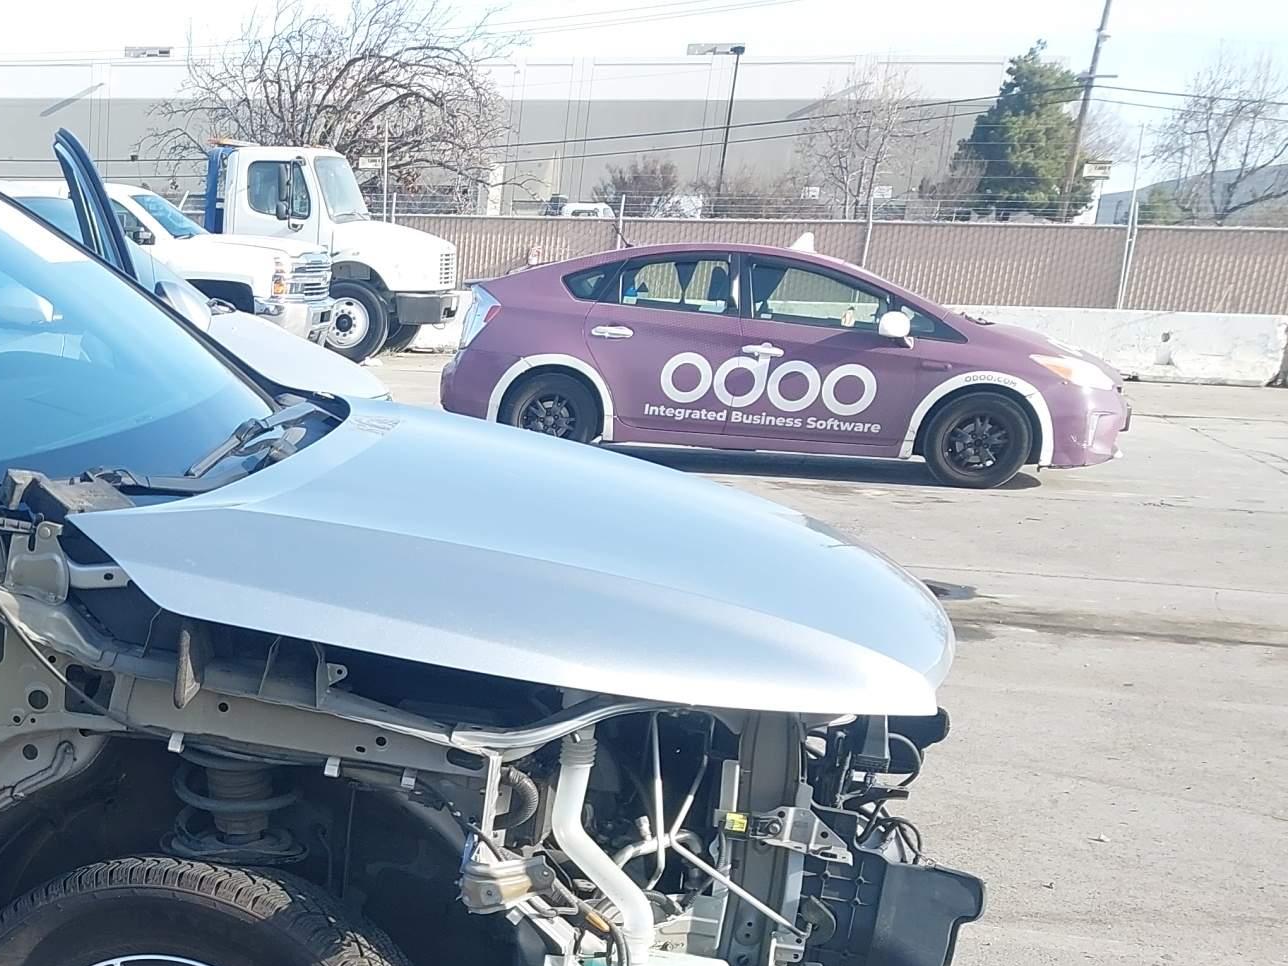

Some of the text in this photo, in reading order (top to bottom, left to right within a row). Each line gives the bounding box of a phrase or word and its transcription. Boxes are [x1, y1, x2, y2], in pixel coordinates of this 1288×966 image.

[660, 351, 878, 416] odoo
[644, 403, 881, 433] Integrated Business Software
